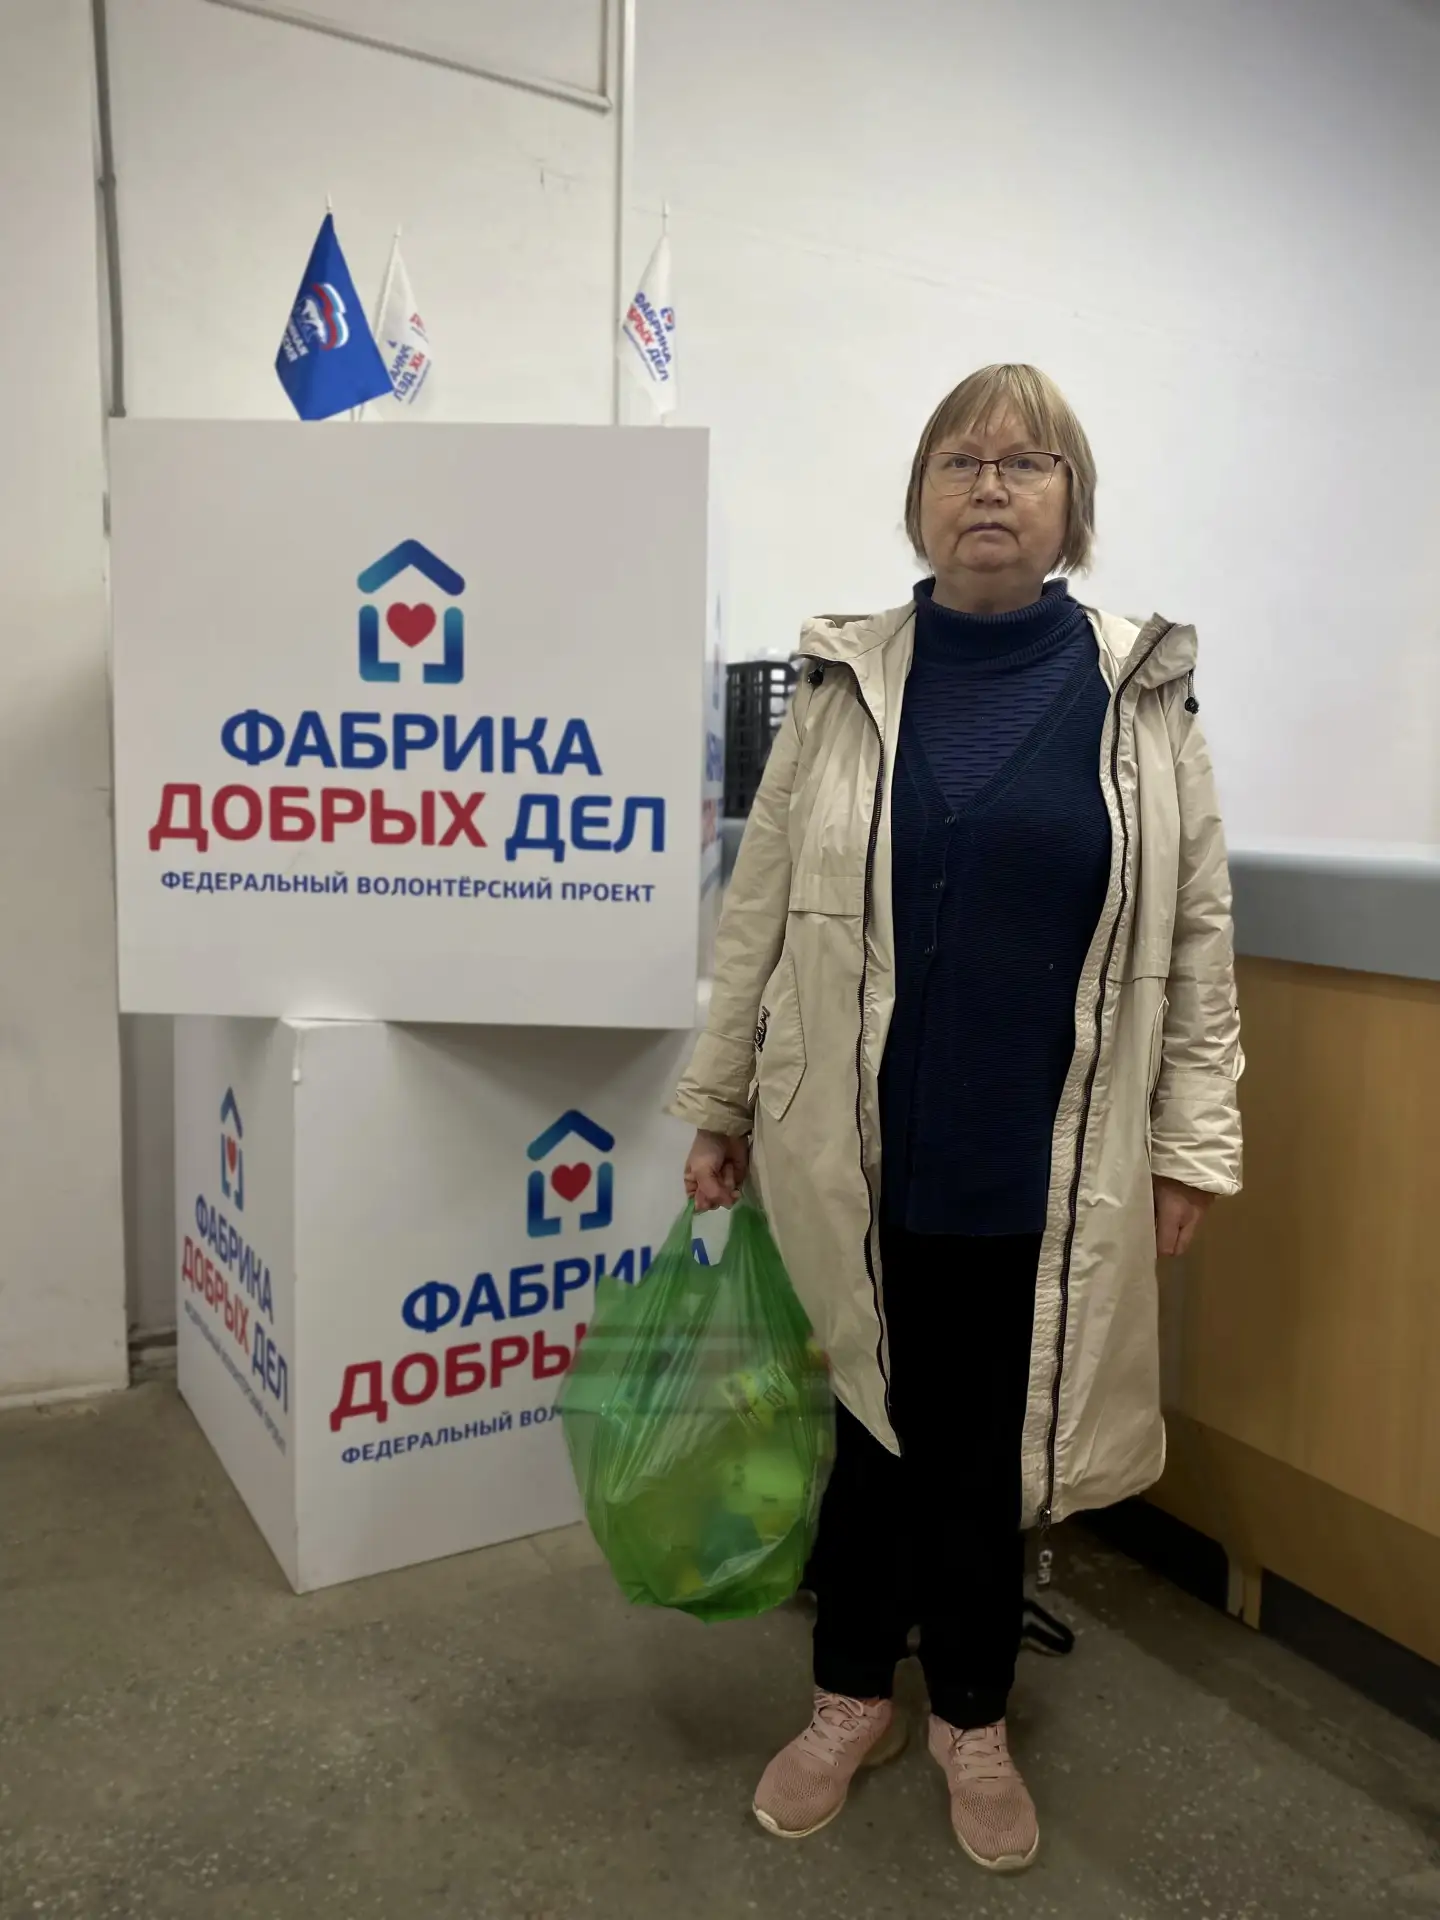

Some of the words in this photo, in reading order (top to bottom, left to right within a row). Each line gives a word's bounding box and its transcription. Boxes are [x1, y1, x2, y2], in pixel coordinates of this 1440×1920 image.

[220, 709, 603, 776] ФАБРИКА
[148, 783, 488, 852] ДОБРЫХ
[504, 793, 666, 862] ДЕЛ
[160, 871, 349, 894] ФЕДЕРАЛЬНЫЙ
[356, 875, 552, 901] ВОЛОНТЁРСКИЙ
[560, 882, 655, 903] ПРОЕКТ
[195, 1194, 273, 1324] ФАБРИКА
[182, 1236, 249, 1356] ДОБРЫХ
[253, 1321, 288, 1416] ДЕЛ
[328, 1322, 586, 1432] ДОБРЫ
[341, 1411, 513, 1464] ФЕДЕРАЛЬНЫЙ
